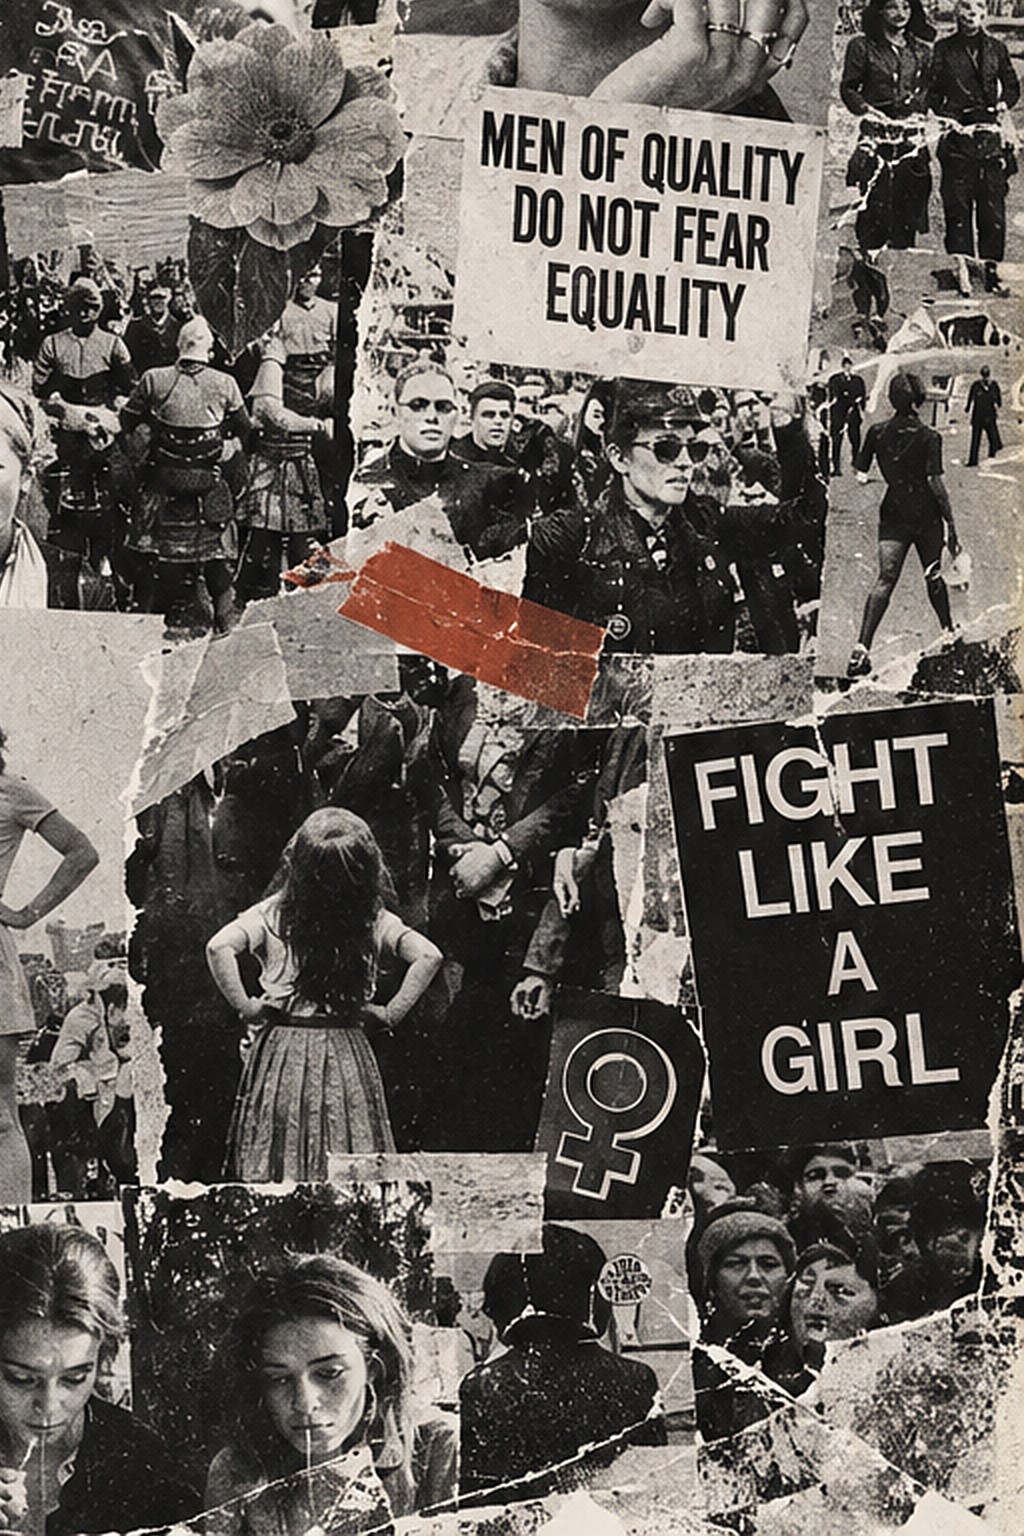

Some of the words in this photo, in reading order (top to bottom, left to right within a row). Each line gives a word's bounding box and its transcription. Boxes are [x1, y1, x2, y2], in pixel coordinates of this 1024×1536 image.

[480, 110, 565, 175] MEN
[580, 124, 629, 181] OF
[642, 131, 805, 205] QUALITY
[513, 185, 563, 247] DO
[578, 193, 659, 258] NOT
[674, 205, 770, 271] FEAR
[545, 262, 746, 341] EQUALITY
[695, 733, 948, 830] FIGHT
[738, 830, 930, 918] LIKE
[827, 930, 878, 995] A
[761, 1013, 960, 1094] GIRL
